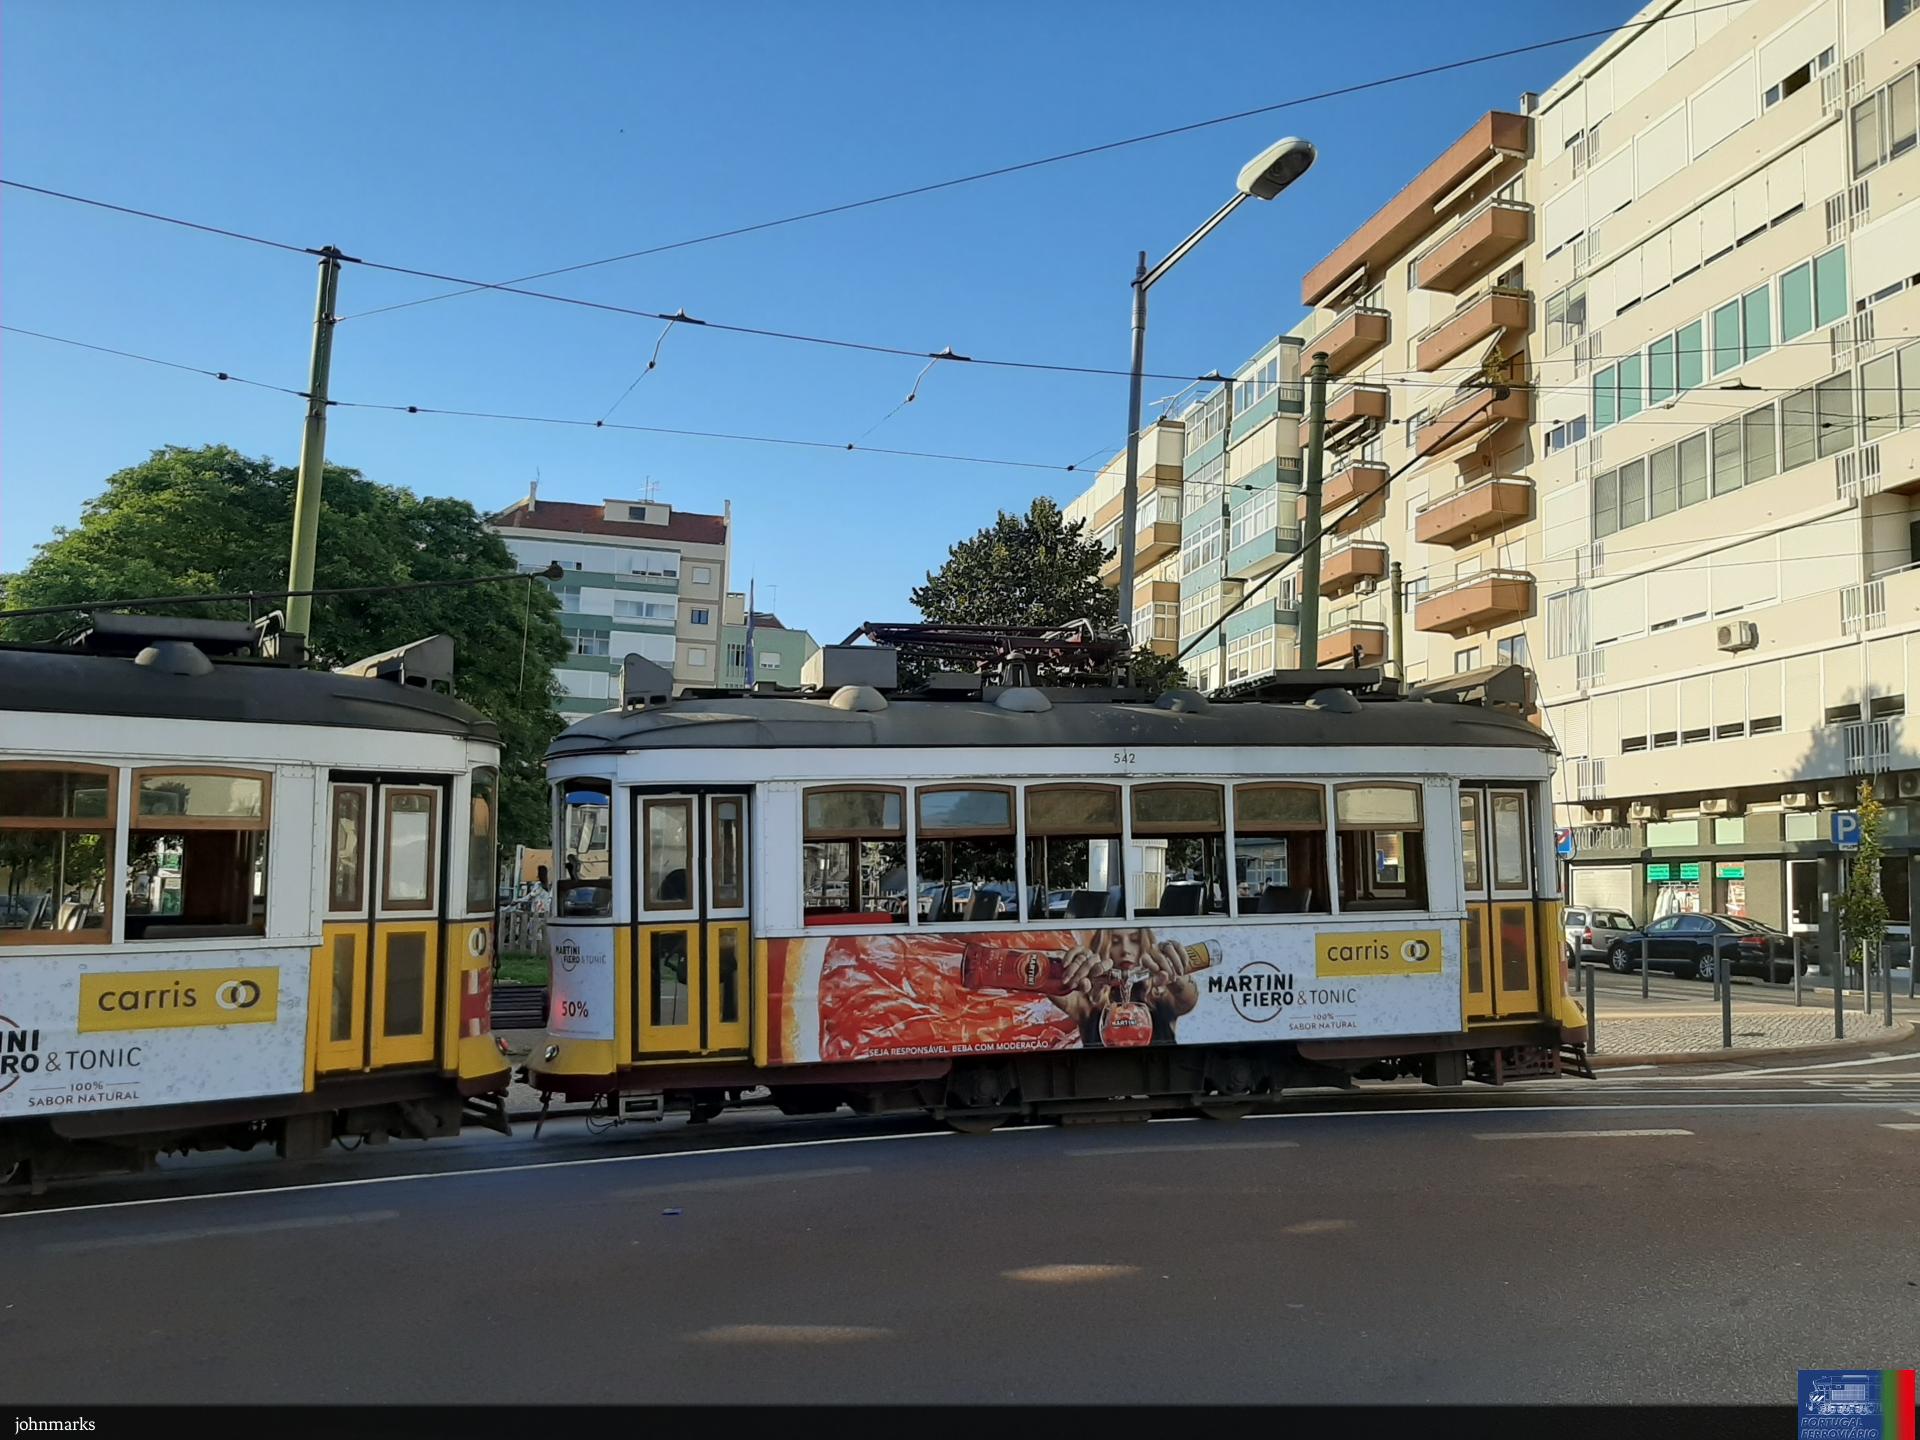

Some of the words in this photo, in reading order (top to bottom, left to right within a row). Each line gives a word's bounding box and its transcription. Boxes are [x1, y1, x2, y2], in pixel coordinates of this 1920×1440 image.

[1113, 752, 1136, 764] 542
[1838, 815, 1857, 841] P
[1327, 939, 1389, 962] carris
[1208, 974, 1293, 993] MARTINI
[98, 980, 197, 1012] carris
[1242, 991, 1294, 1007] FIERO
[1297, 993, 1307, 1005] &
[1310, 988, 1357, 1005] TONIC
[561, 1001, 589, 1017] 50%
[1289, 1023, 1317, 1031] SABOR
[1318, 1021, 1357, 1029] NATURAL
[869, 1048, 889, 1057] SEJA
[952, 1044, 973, 1053] BEBA
[974, 1043, 995, 1051] COM
[996, 1039, 1049, 1050] MODERAÇÃO
[45, 1051, 61, 1072] &
[65, 1046, 142, 1071] TONIC
[71, 1081, 104, 1092] 100%
[28, 1095, 73, 1107] SABOR
[78, 1090, 140, 1103] NATURAL
